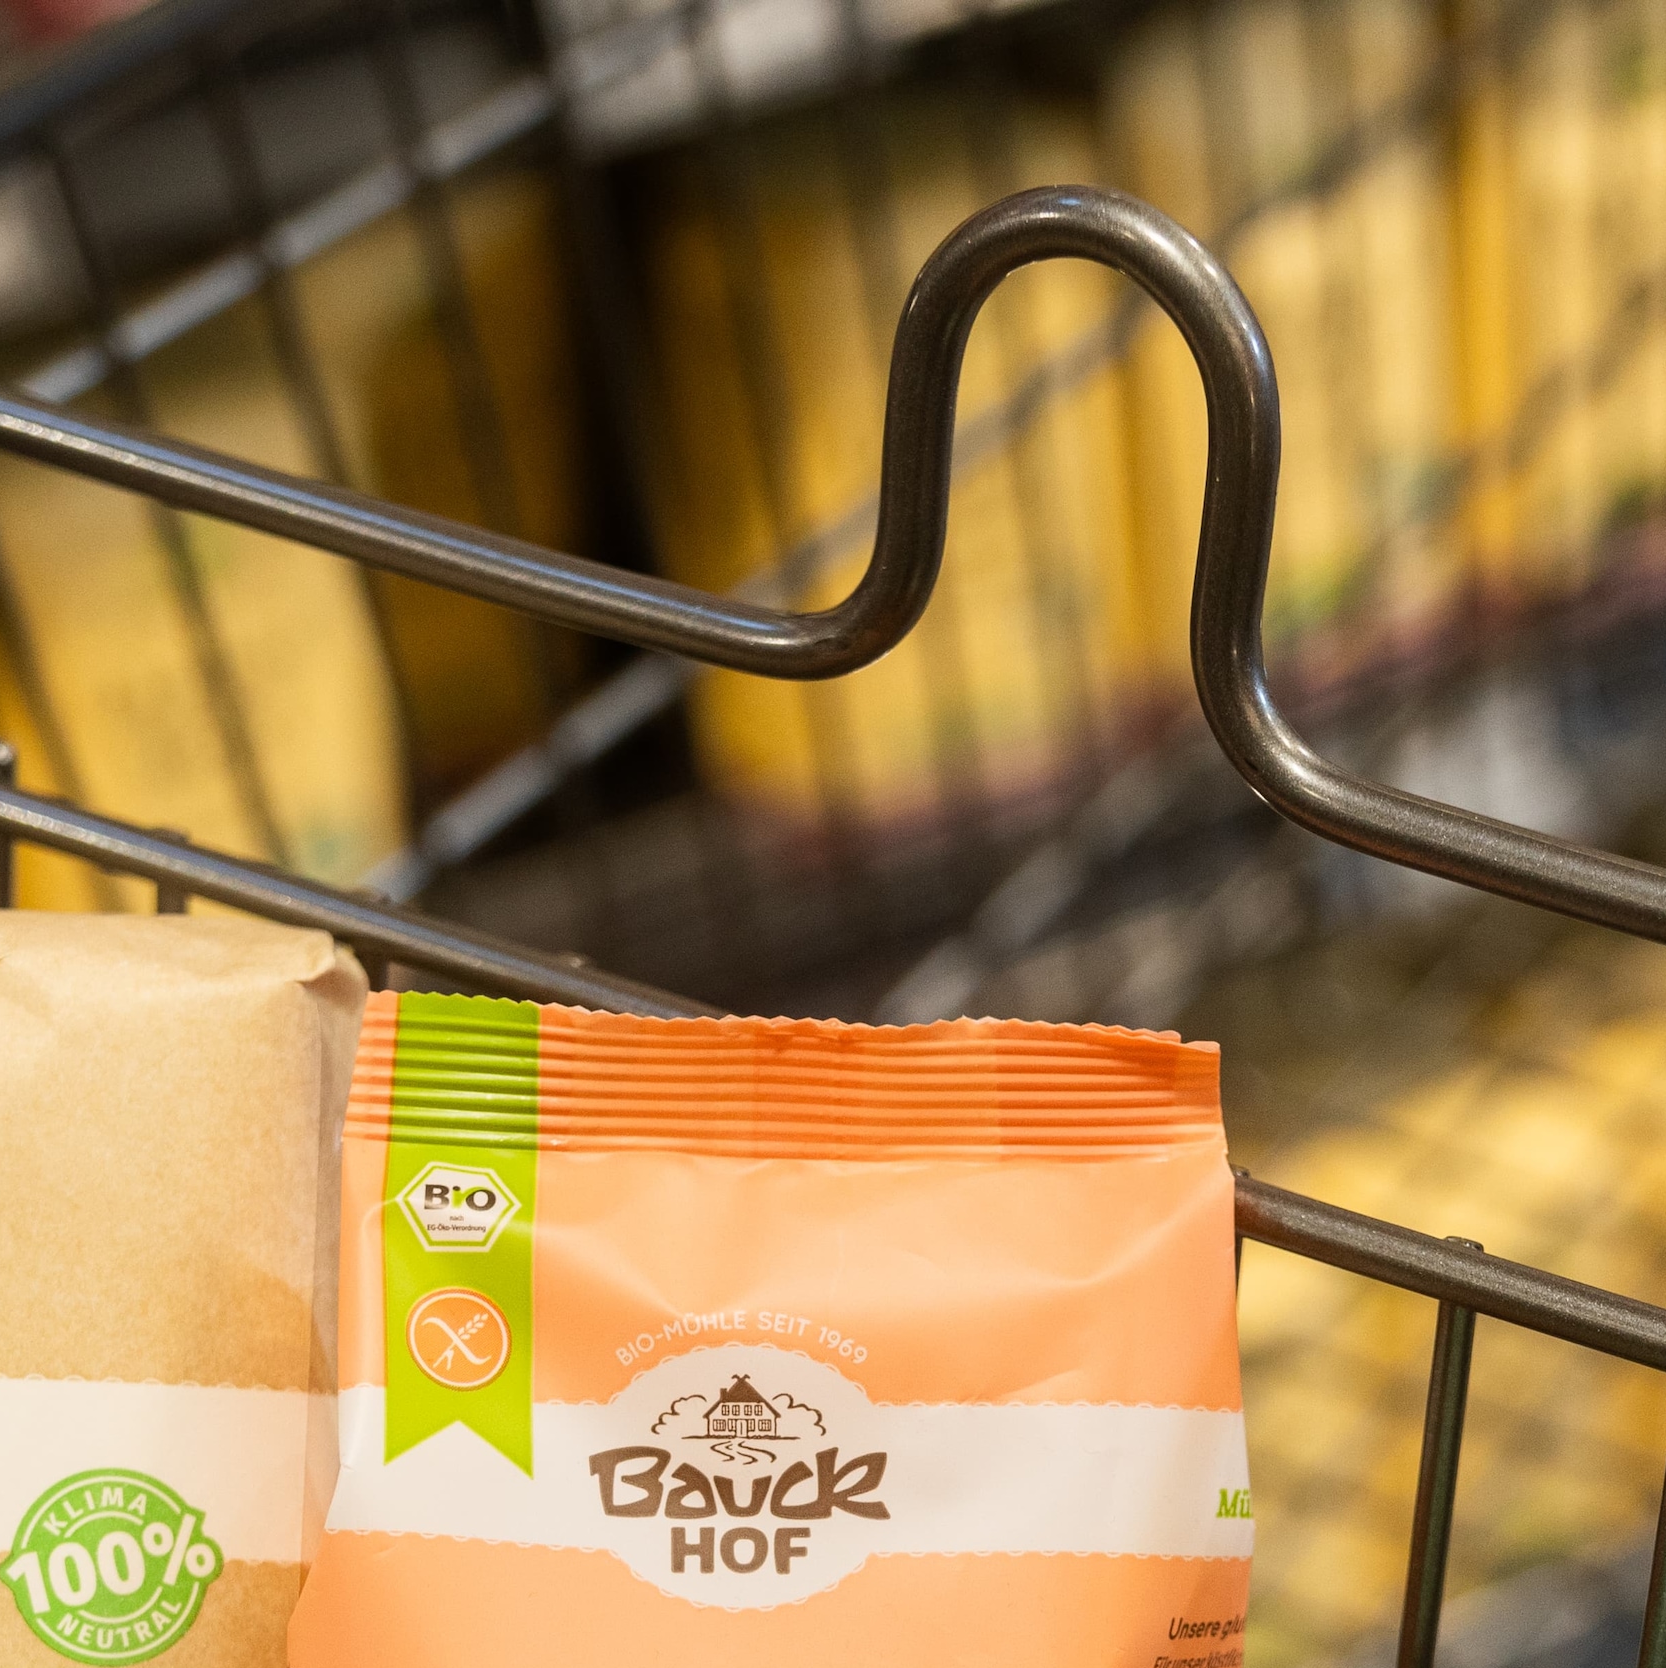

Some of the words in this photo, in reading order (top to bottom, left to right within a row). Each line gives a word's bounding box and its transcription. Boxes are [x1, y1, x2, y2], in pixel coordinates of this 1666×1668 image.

[615, 1310, 747, 1366] BIO-MÜHLE
[757, 1311, 811, 1337] SEIT
[818, 1326, 868, 1364] 1969
[42, 1486, 147, 1537] KLIMA
[6, 1512, 216, 1614] 100%
[671, 1527, 811, 1575] HOF
[56, 1600, 182, 1650] NEUTRAL
[1168, 1617, 1221, 1640] Unsere
